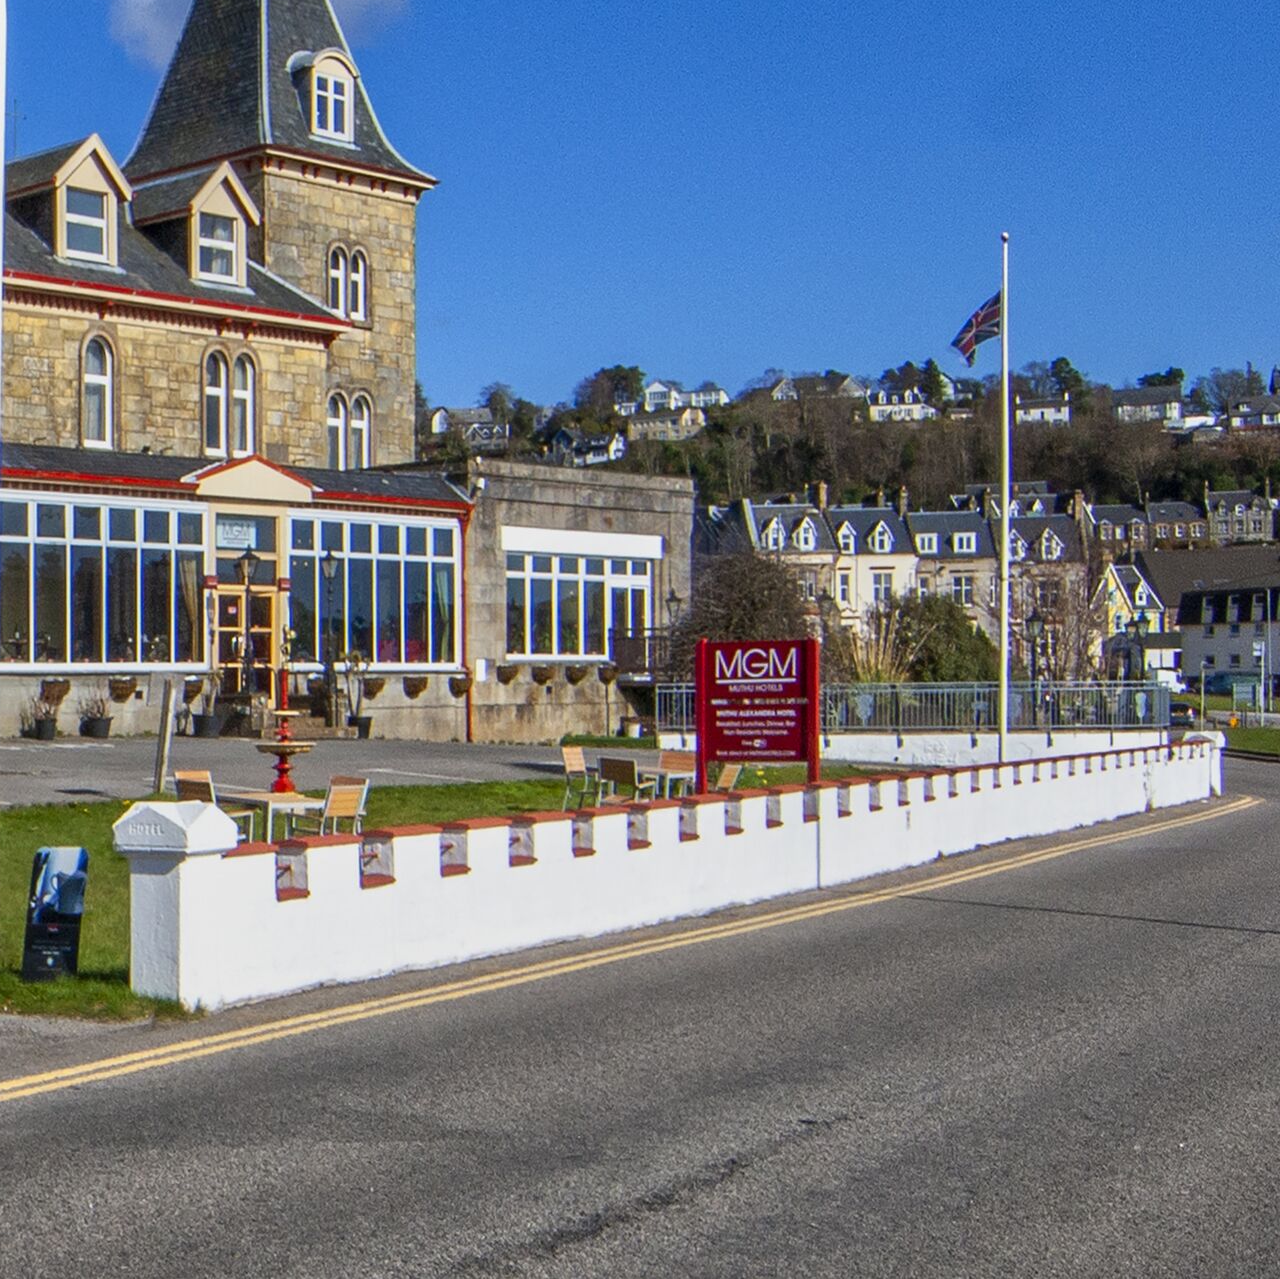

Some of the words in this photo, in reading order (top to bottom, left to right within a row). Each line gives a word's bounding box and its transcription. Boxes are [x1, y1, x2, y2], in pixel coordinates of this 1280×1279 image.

[715, 648, 797, 678] MGM
[728, 684, 754, 693] MUTHU
[755, 683, 783, 692] HOTELS
[715, 708, 737, 717] MUTHU
[738, 709, 775, 717] ALEXANDRA
[776, 708, 796, 717] HOTEL
